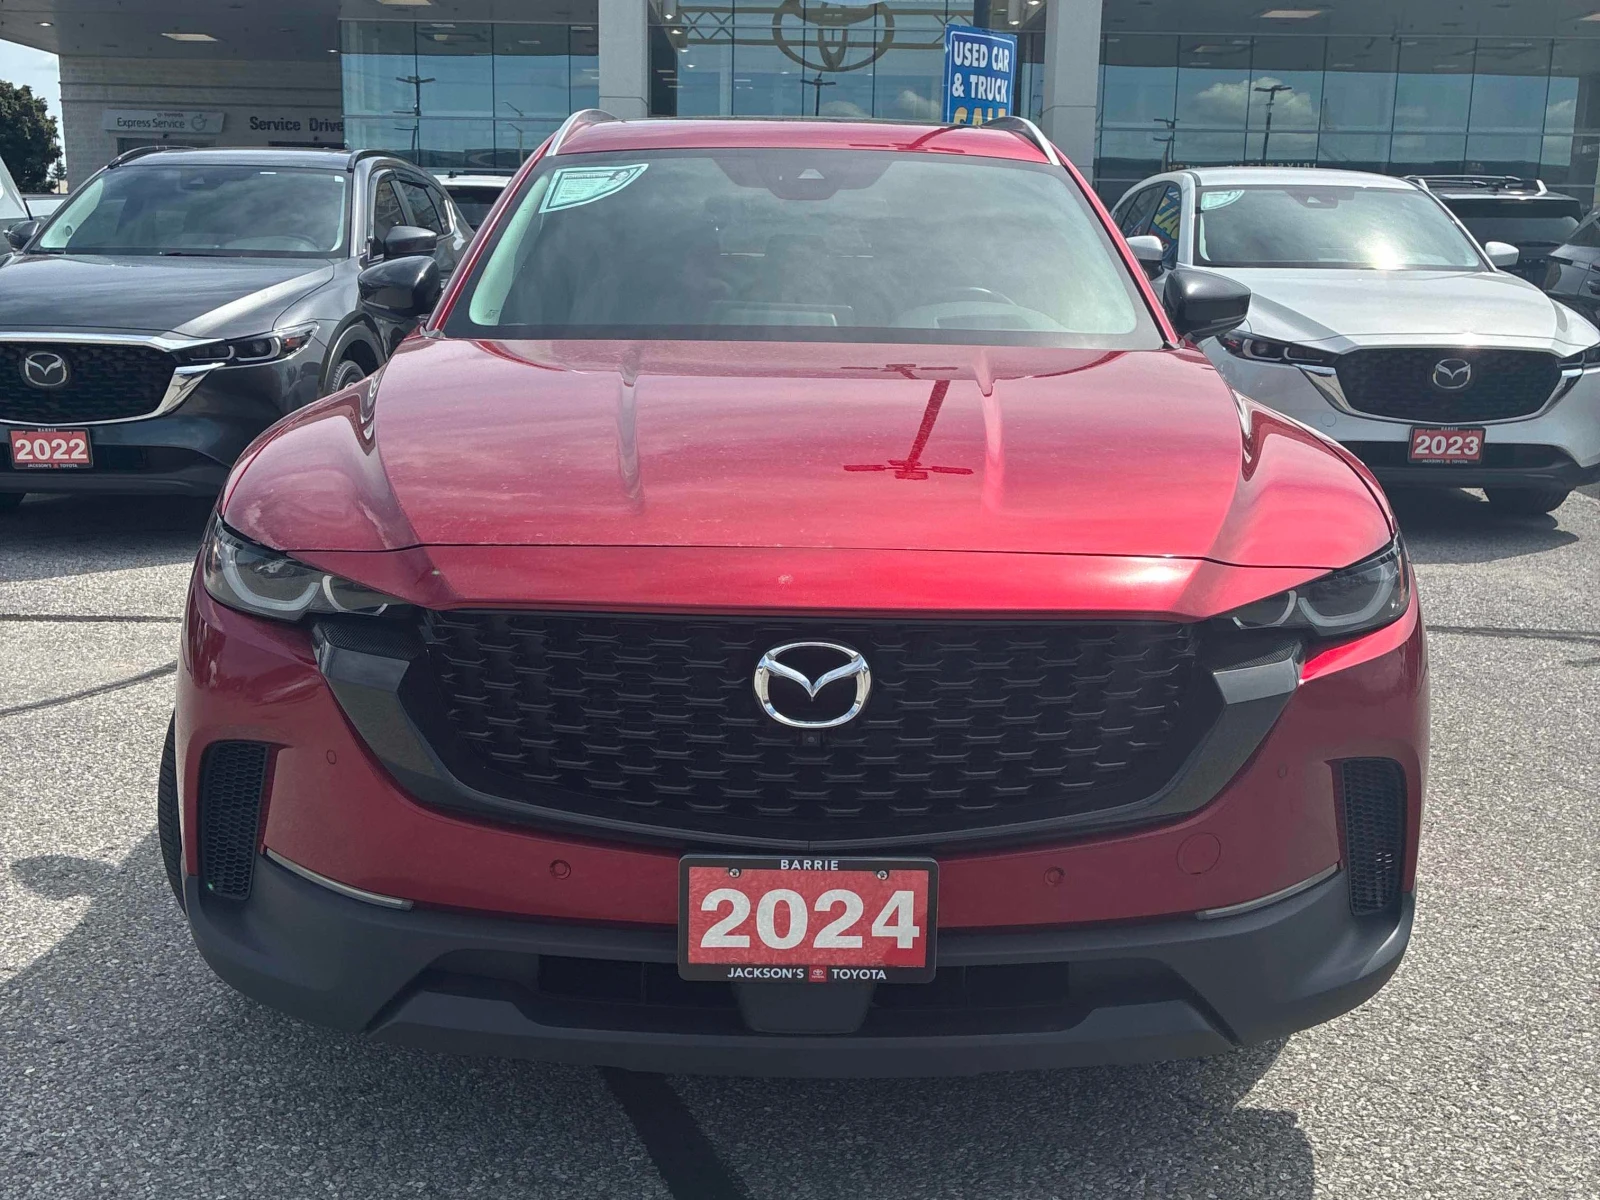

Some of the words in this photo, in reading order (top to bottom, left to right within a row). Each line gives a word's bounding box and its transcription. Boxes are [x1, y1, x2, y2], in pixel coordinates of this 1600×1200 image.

[953, 41, 988, 68] USED
[991, 46, 1010, 73] CAR
[951, 73, 965, 98] &
[969, 75, 1008, 103] TRUCK
[117, 117, 151, 128] Express
[152, 118, 185, 128] Service
[249, 116, 301, 131] Service
[308, 117, 344, 131] Drive
[15, 439, 87, 460] 2022
[1414, 435, 1479, 455] 2023
[781, 860, 839, 871] BARRIE
[701, 888, 920, 949] 2024
[727, 967, 804, 979] JACKSON'S
[832, 969, 887, 980] TOYOTA
